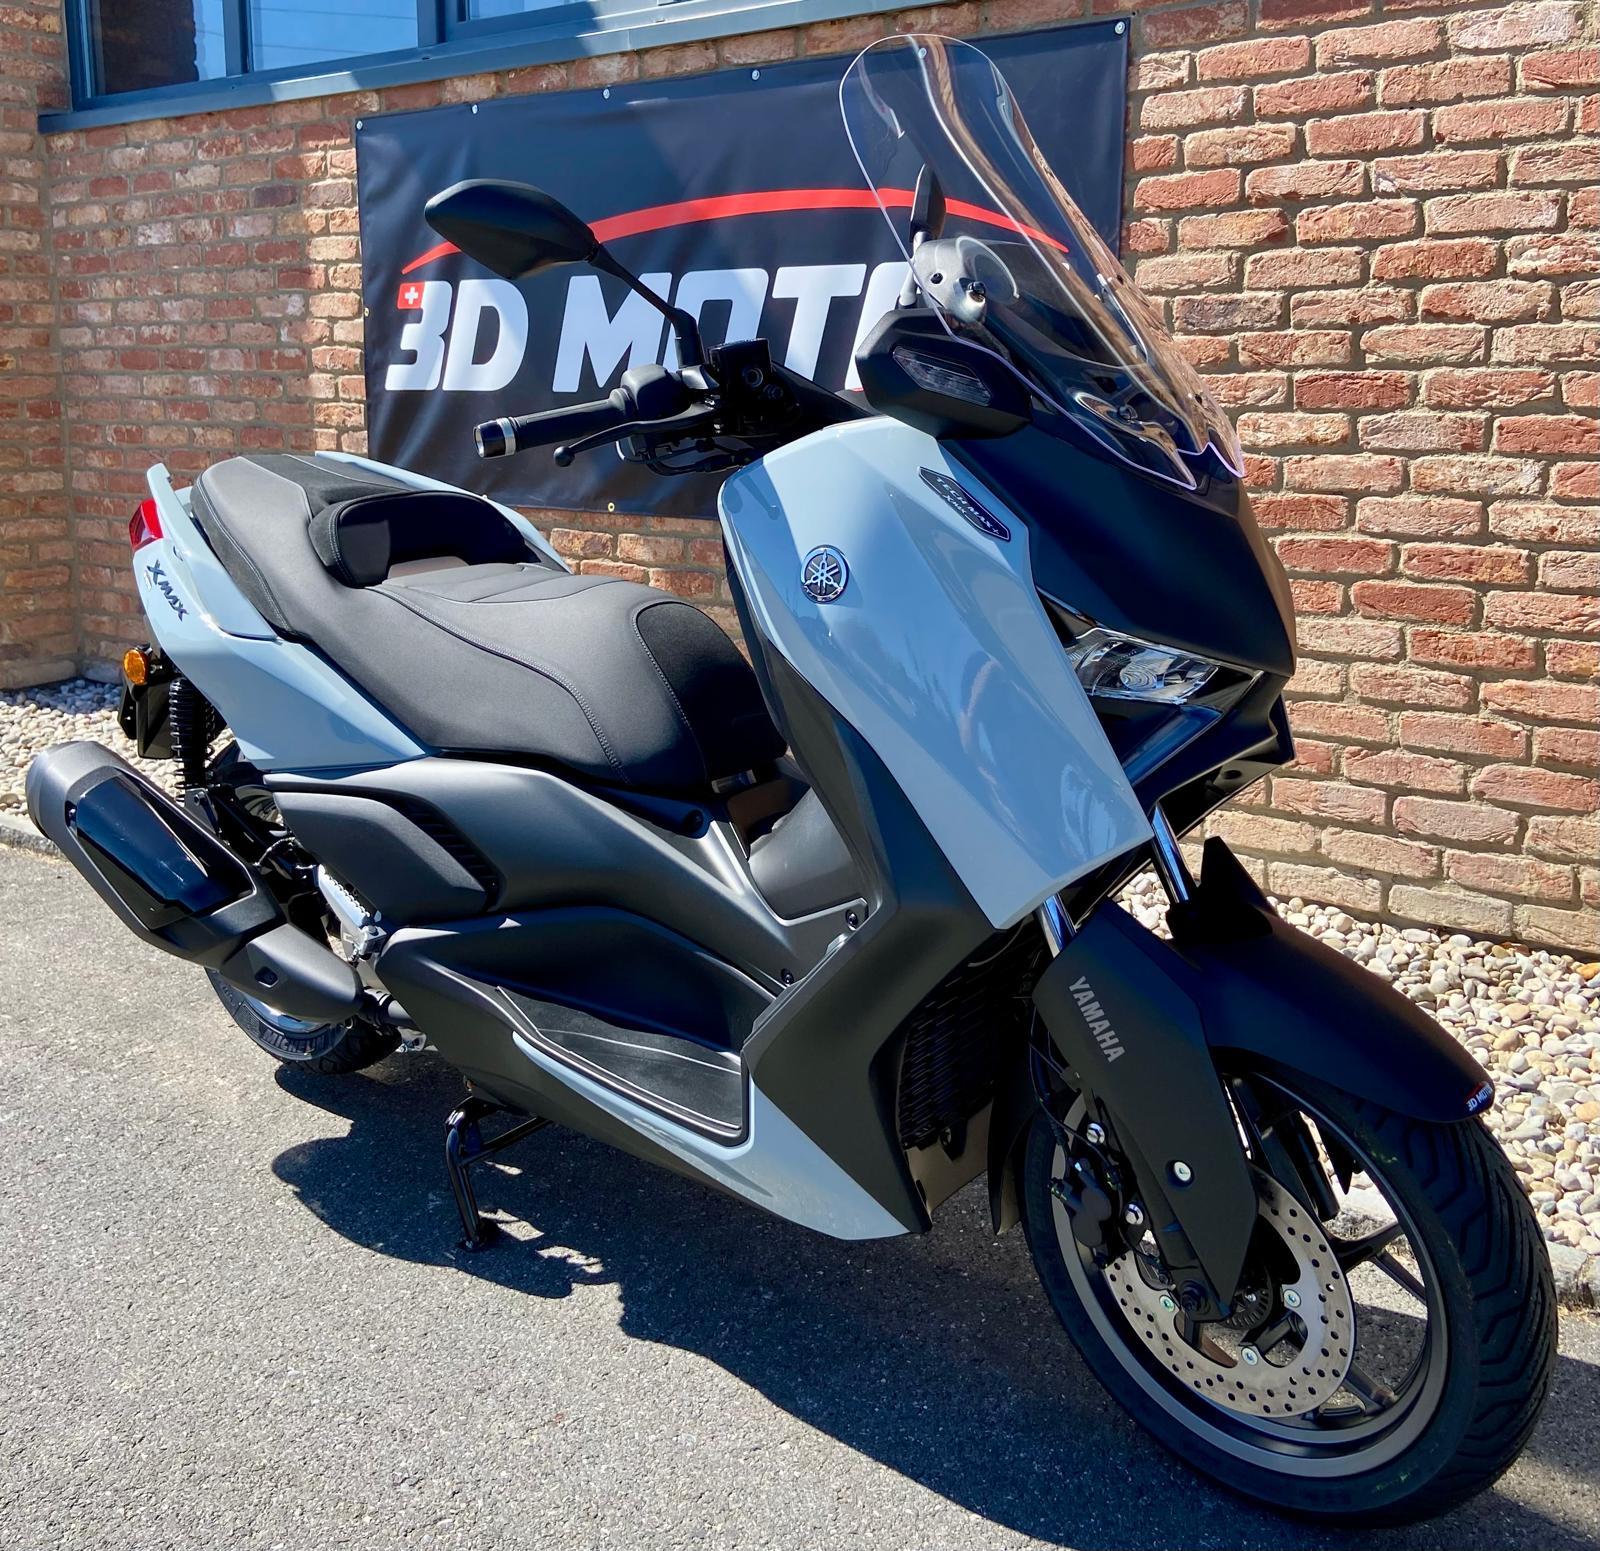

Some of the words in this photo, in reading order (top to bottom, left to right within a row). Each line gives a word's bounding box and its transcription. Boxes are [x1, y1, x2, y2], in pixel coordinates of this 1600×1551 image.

[384, 279, 529, 392] 3D
[936, 477, 967, 505] TECH
[262, 1028, 325, 1054] MICHELIN
[1068, 975, 1126, 1063] YAMAHA
